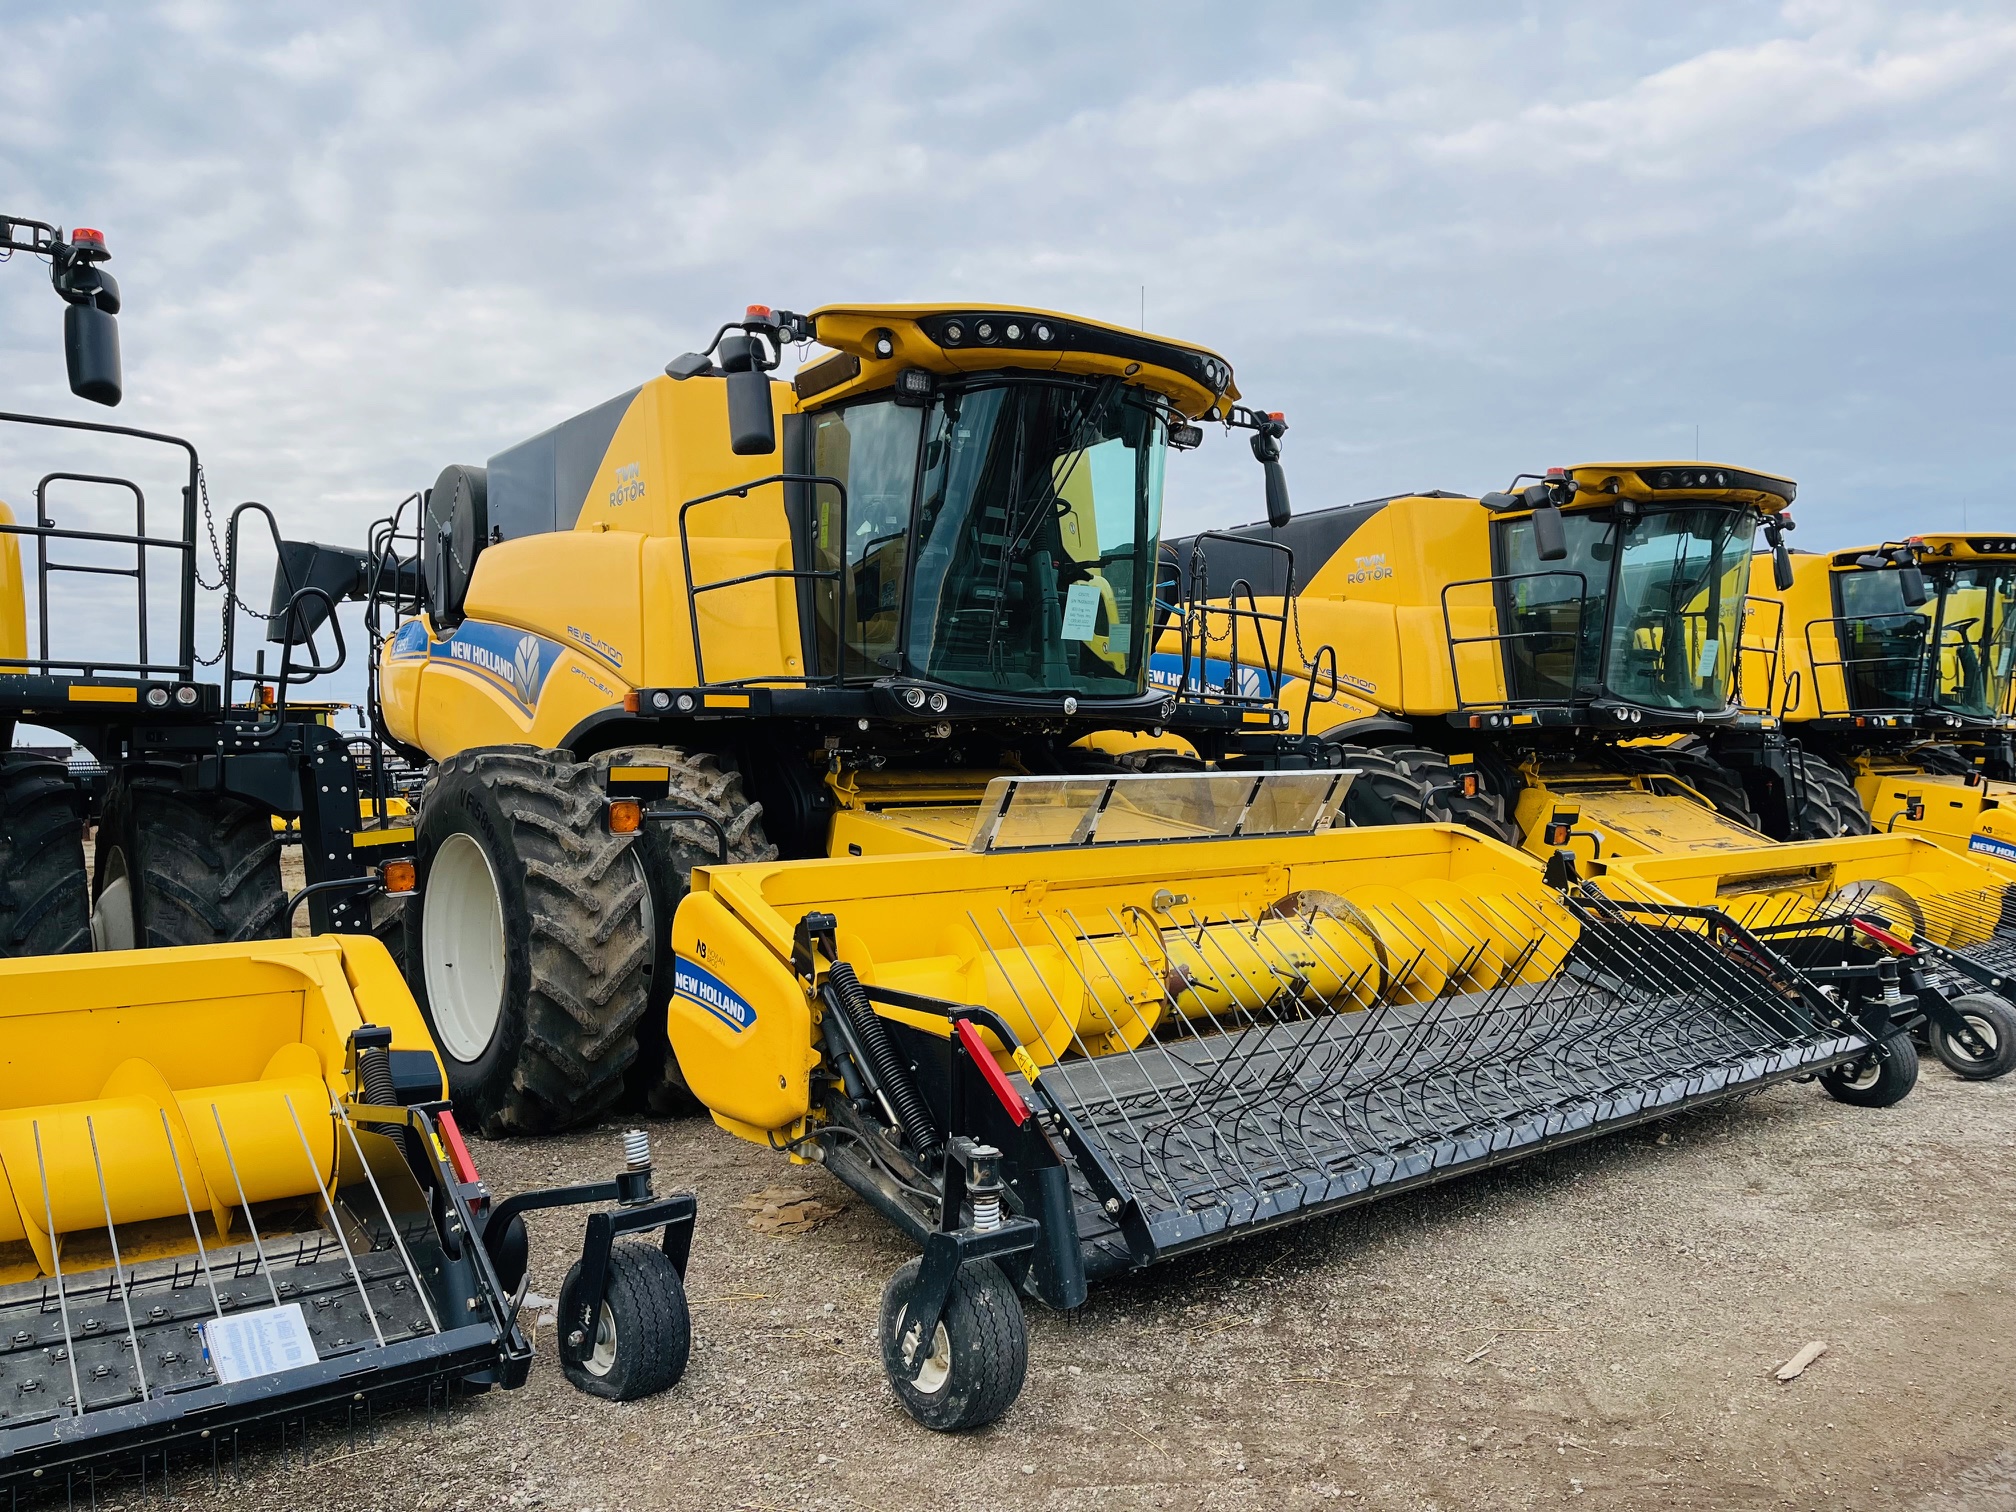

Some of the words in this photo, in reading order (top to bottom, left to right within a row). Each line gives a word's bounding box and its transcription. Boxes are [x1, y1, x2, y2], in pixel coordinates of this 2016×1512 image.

[615, 460, 639, 484] TWIN
[609, 480, 646, 507] ROTOR
[1354, 552, 1386, 569] TWIN
[1347, 566, 1393, 585] ROTOR
[567, 625, 624, 663] REVELATION
[451, 640, 472, 661] NEW
[472, 645, 514, 683] HOLLAND
[571, 665, 614, 698] OPTI-CLEAN
[1149, 669, 1165, 684] EW
[460, 788, 475, 811] VF
[1971, 841, 1996, 853] NEW
[1996, 846, 2016, 859] HOL
[675, 971, 698, 995] NEW
[699, 980, 746, 1023] HOLLAND
